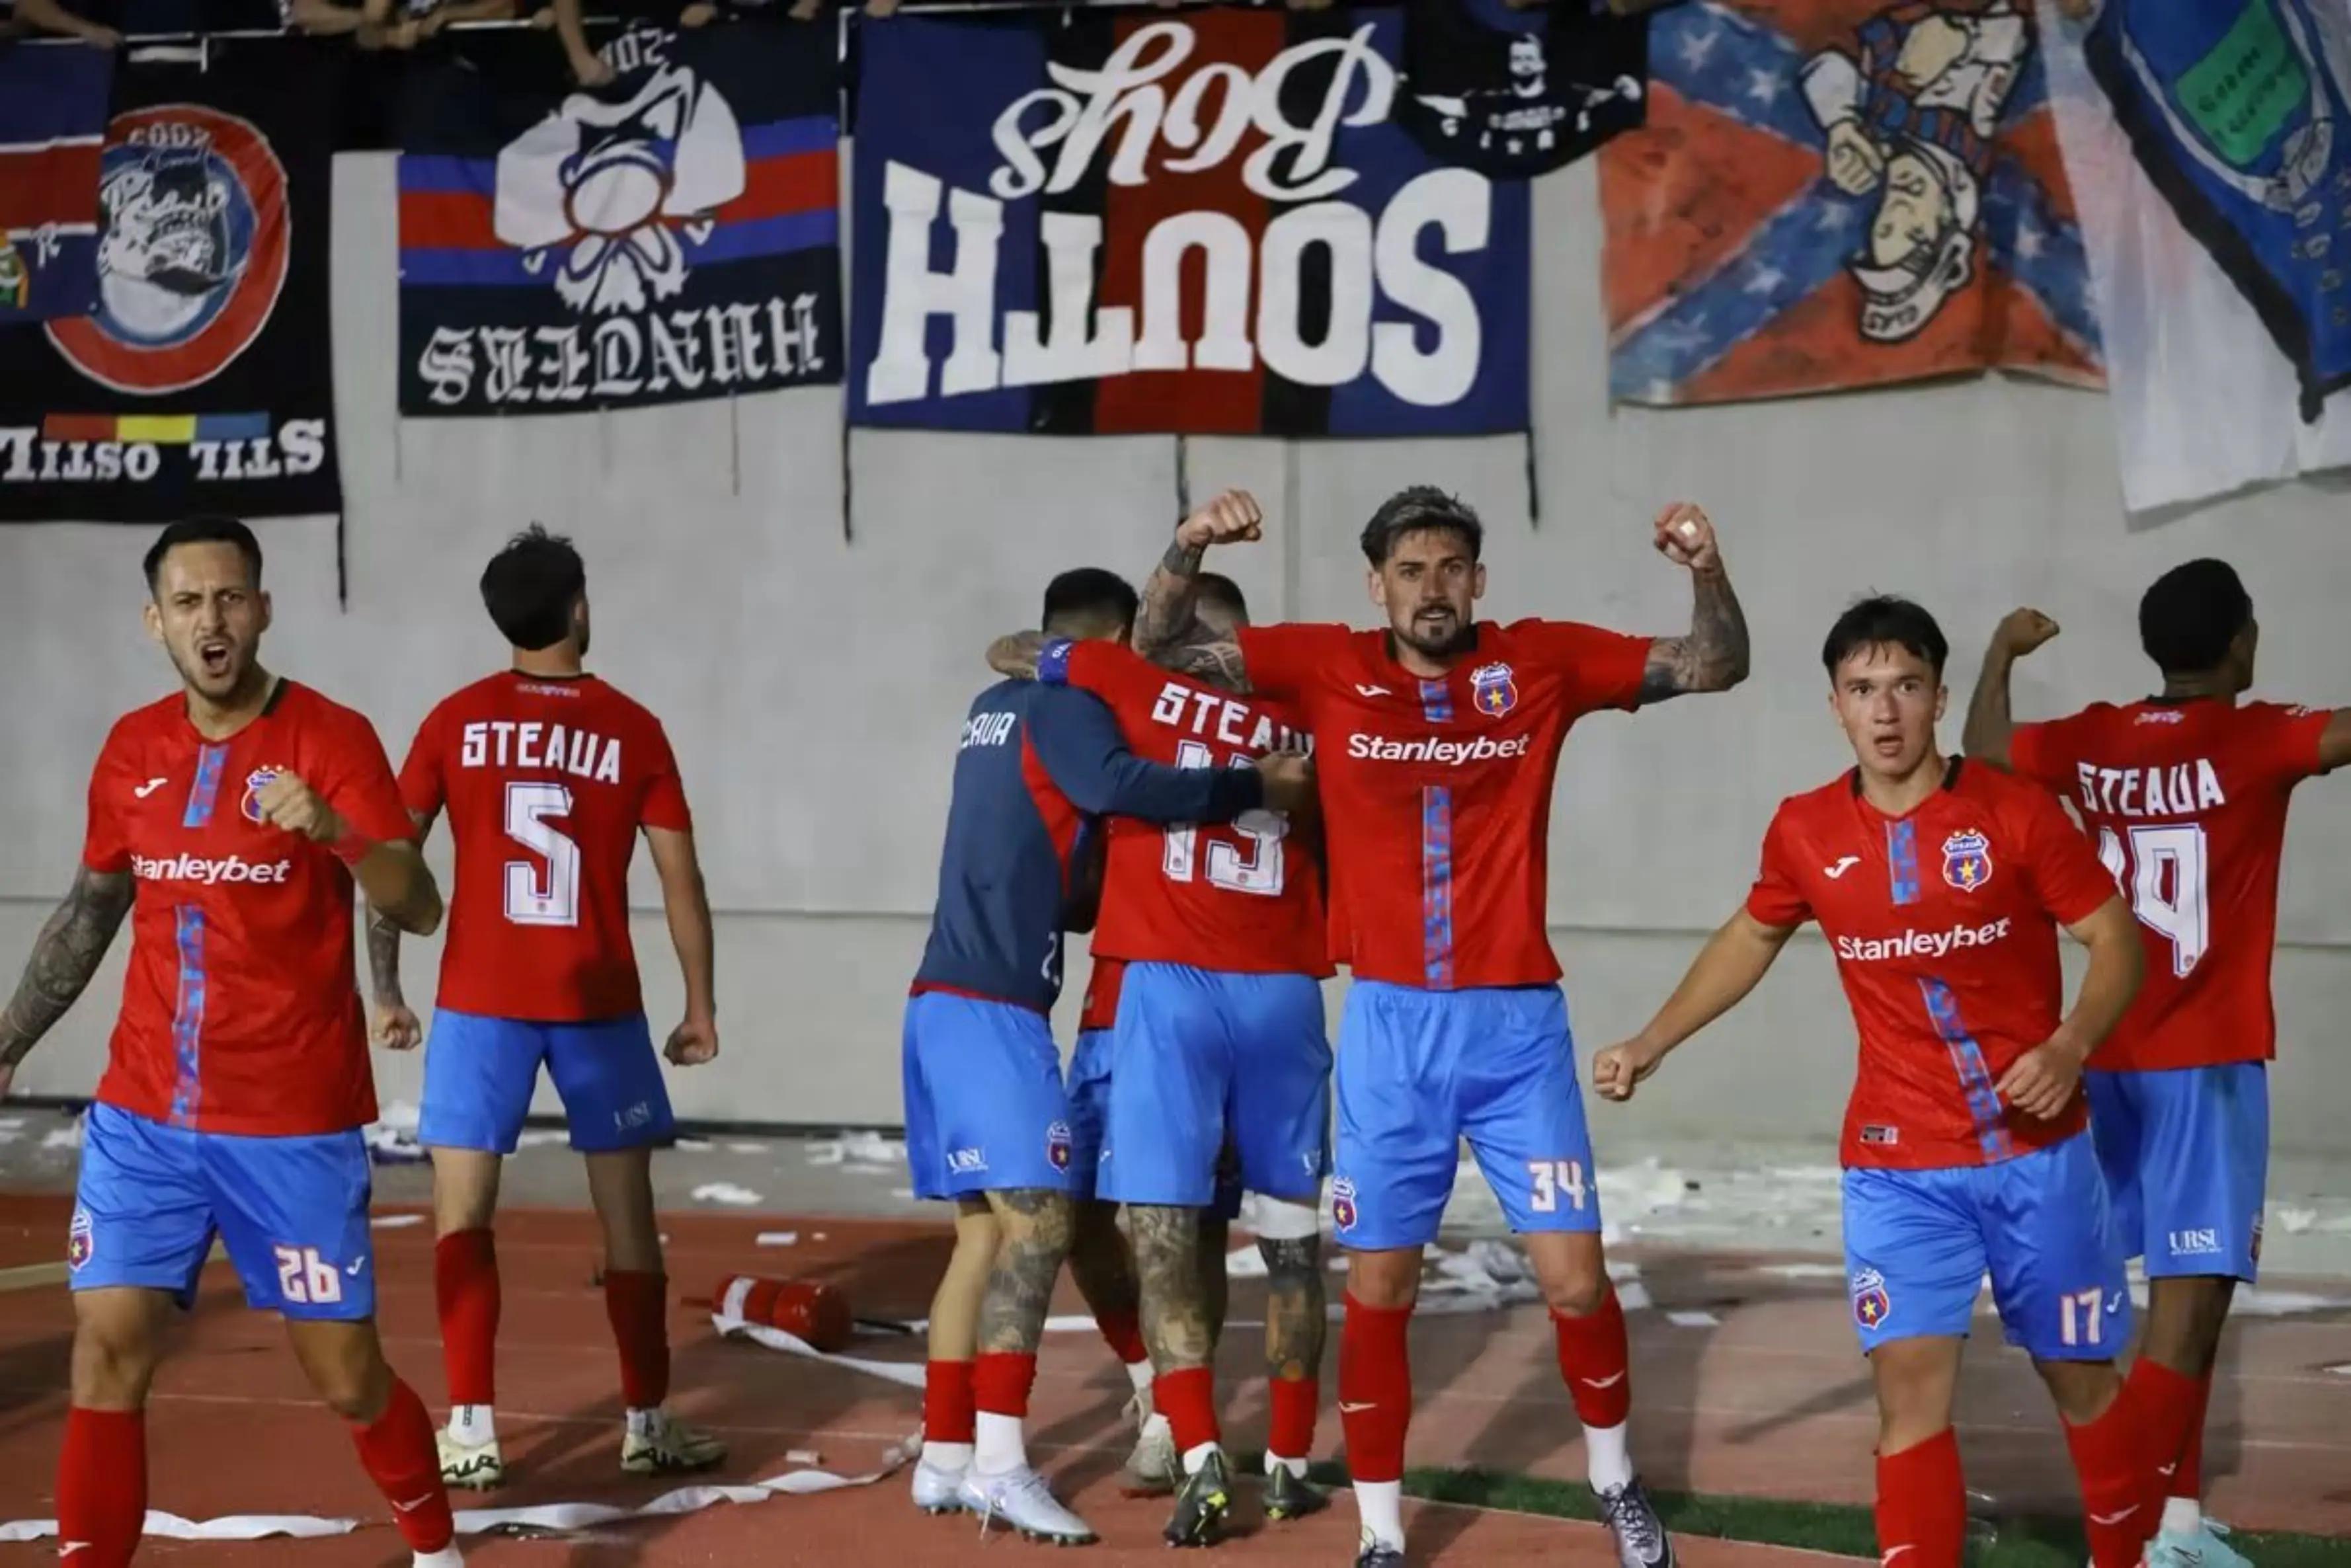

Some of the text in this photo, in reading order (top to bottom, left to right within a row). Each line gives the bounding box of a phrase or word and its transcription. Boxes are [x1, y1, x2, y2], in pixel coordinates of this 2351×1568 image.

[988, 22, 1398, 200] Boys
[867, 160, 1492, 406] SOUTH
[418, 292, 824, 404] HUNTERS
[0, 418, 326, 481] STIL OSTIL
[1151, 681, 1315, 760] STEAU
[1347, 730, 1530, 766] Stanleybet
[461, 721, 621, 784] STEAUA
[2077, 758, 2225, 816] STEAUA
[504, 781, 580, 926] 5
[1838, 916, 2012, 962] Stanleybet
[1527, 1158, 1586, 1212] 34
[274, 1245, 342, 1305] 26
[2059, 1287, 2104, 1347] 17
